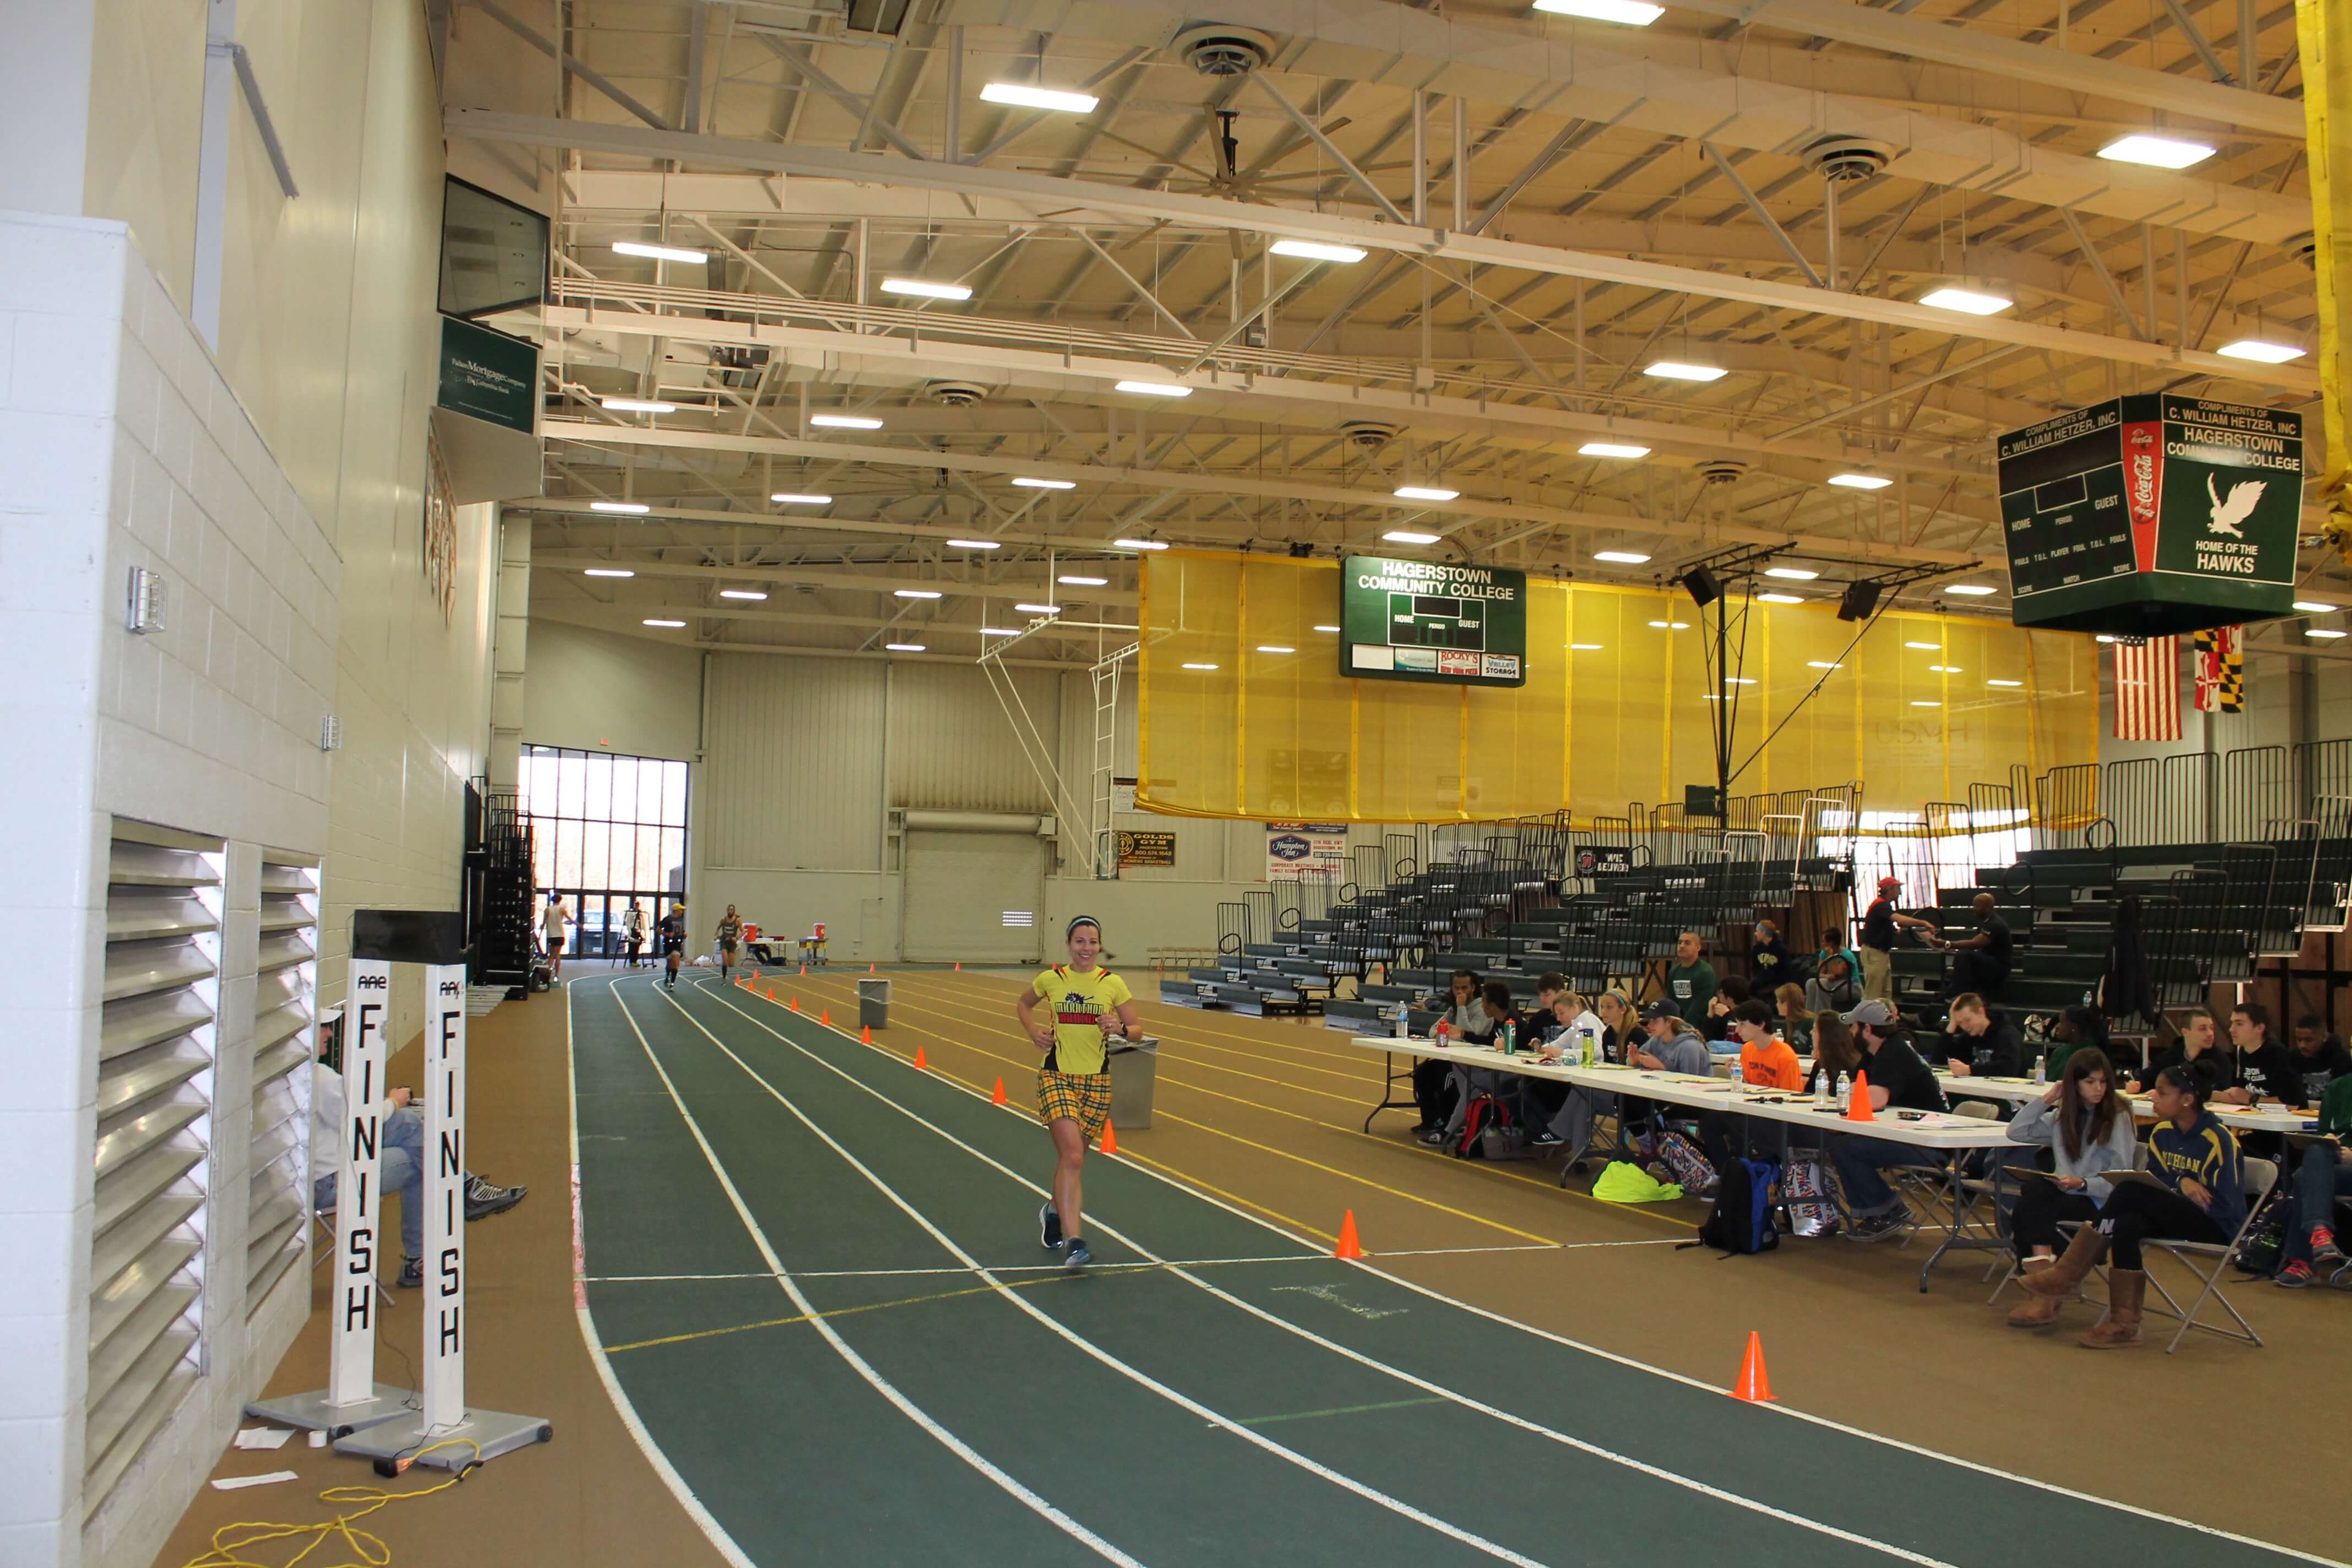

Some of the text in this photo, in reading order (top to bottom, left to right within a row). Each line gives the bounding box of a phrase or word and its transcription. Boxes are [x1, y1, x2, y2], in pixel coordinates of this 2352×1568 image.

[2198, 401, 2256, 416] COMPLIMENTS
[2026, 410, 2089, 437] COMPLIMENTS OF
[2169, 407, 2297, 435] C. WILLIAM HETZER, INC
[2002, 412, 2116, 456] C. WILLIAM HETZER, INC
[2184, 426, 2284, 453] HAGERSTOWN
[2167, 442, 2300, 471] COMMU COLLEGE
[2095, 495, 2119, 510] GUEST
[2011, 518, 2032, 532] HOME
[2055, 515, 2073, 526] PERIOD
[2015, 556, 2030, 567] FOULS
[2050, 547, 2070, 558] PLAYER
[2073, 543, 2086, 552] FOUL
[2109, 533, 2127, 544] FOULS
[2196, 540, 2259, 555] HOME OF THE
[2196, 553, 2255, 574] HAWKS
[1382, 561, 1491, 584] HAGERSTOWN
[2063, 575, 2080, 584] MATCH
[1359, 575, 1514, 600] COMMUNITY COLLEGE
[1394, 614, 1414, 624] HOME
[1458, 619, 1480, 628] GUEST
[1441, 650, 1478, 664] ROCKY'S
[1487, 659, 1516, 668] VALLEY
[1272, 840, 1308, 850] Hampton
[1281, 848, 1298, 858] Inn
[347, 1004, 382, 1332] FINISH
[440, 1011, 461, 1357] FINISH
